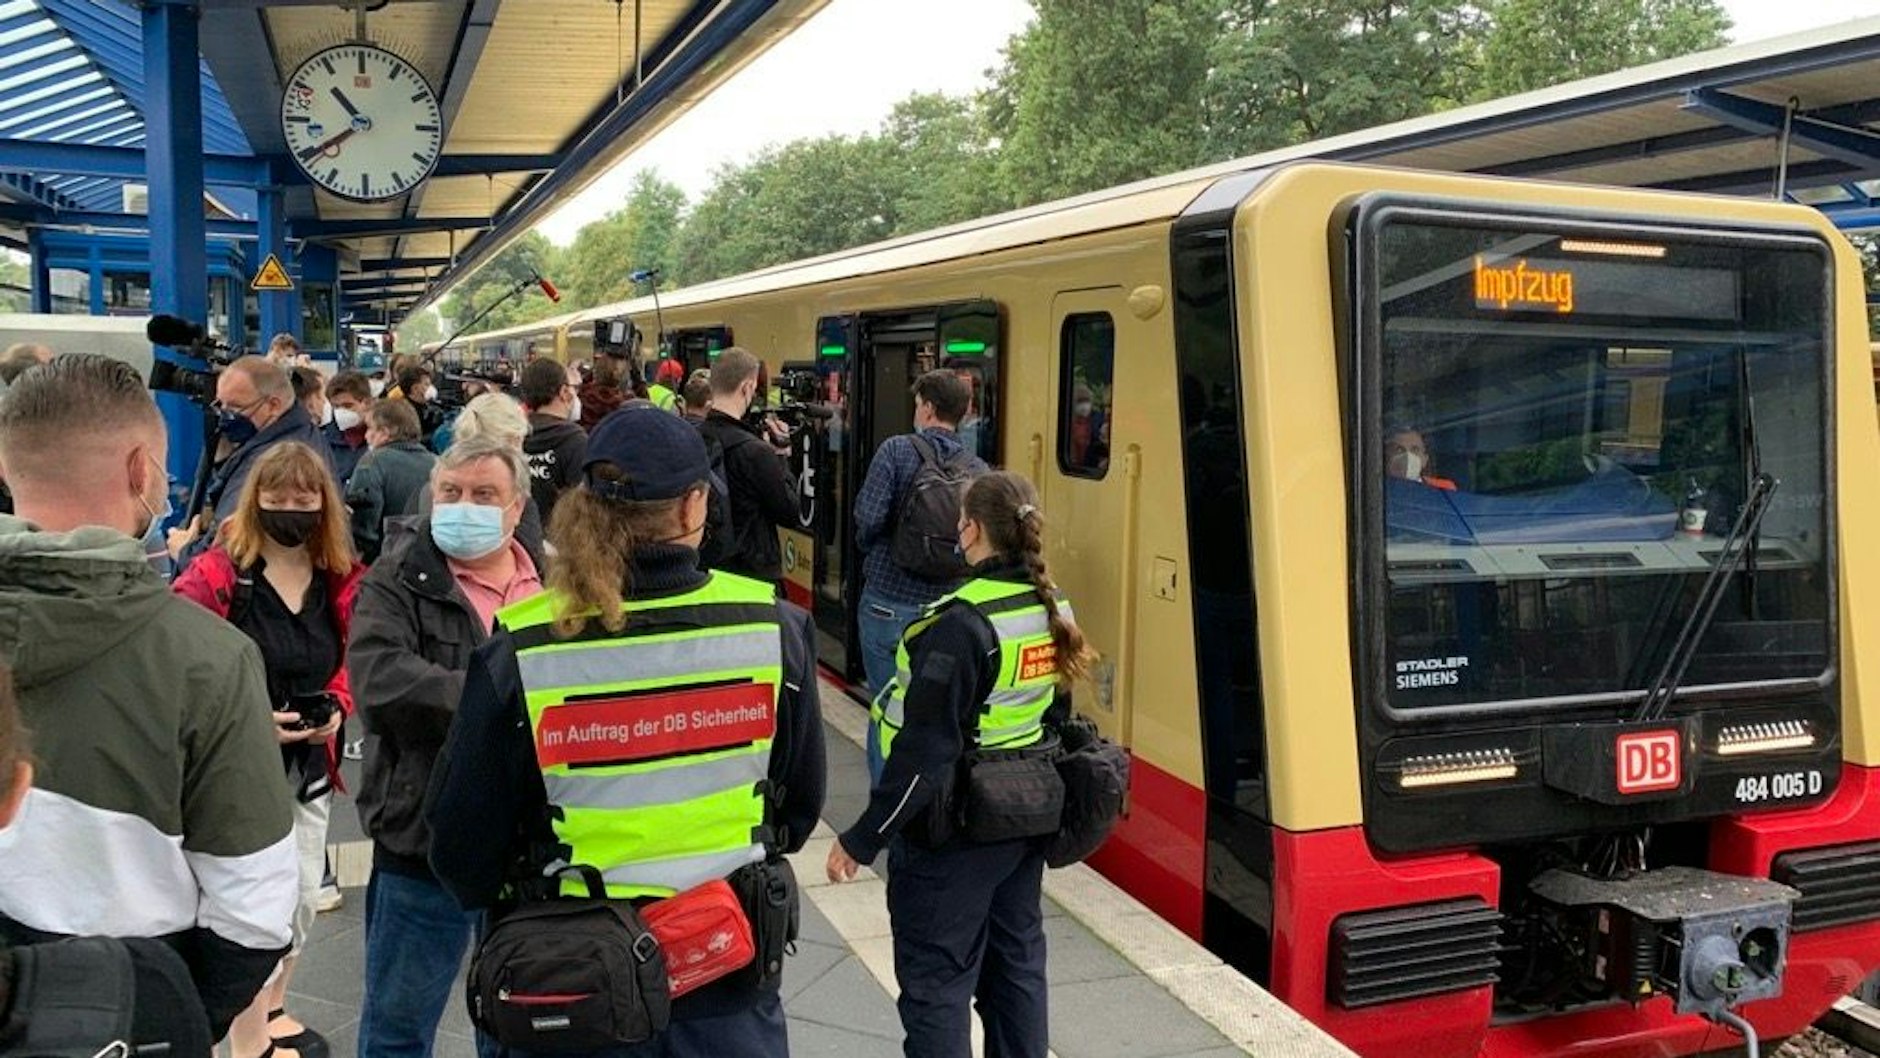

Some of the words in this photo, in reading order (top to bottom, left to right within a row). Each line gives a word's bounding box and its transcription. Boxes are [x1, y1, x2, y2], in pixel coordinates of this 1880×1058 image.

[1476, 255, 1573, 312] Impfzug
[1396, 656, 1469, 672] STADLER
[1396, 670, 1459, 690] SIEMENS
[543, 731, 563, 747] Im
[566, 722, 629, 743] Auftrag
[633, 719, 659, 738] der
[664, 713, 687, 733] DB
[691, 703, 768, 729] Sicherheit
[1625, 742, 1672, 783] DB
[1735, 775, 1768, 802] 484
[1772, 772, 1805, 798] 005
[1809, 771, 1822, 794] D
